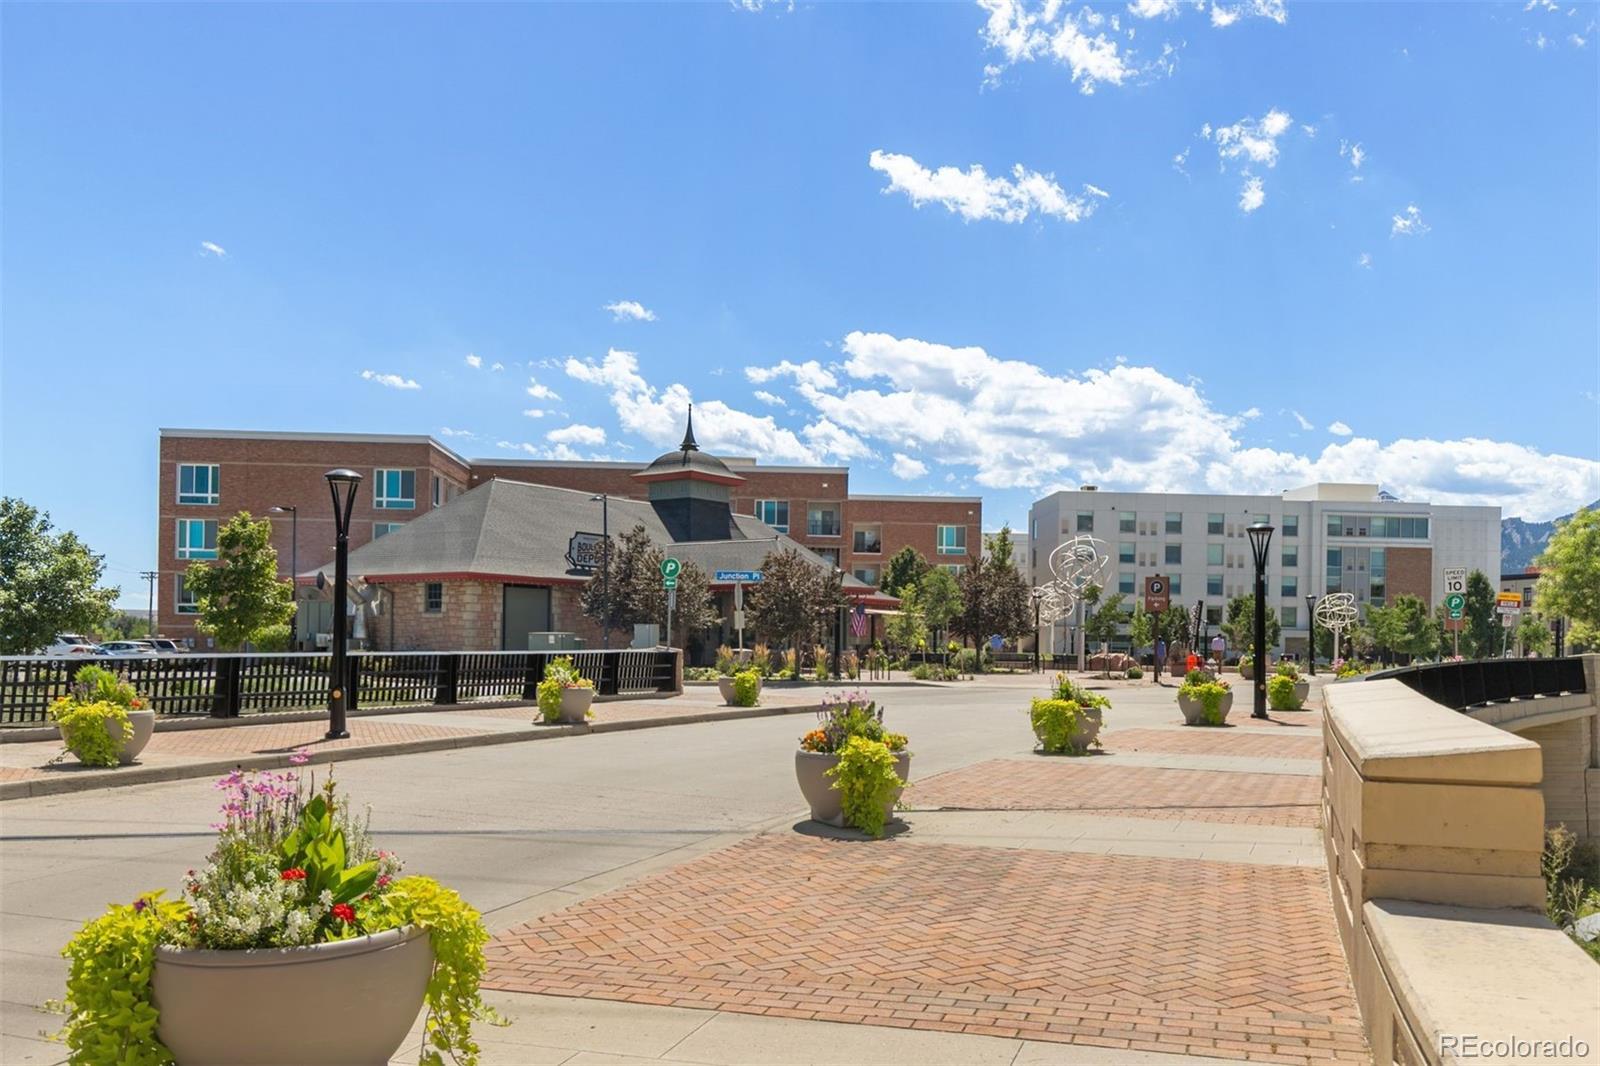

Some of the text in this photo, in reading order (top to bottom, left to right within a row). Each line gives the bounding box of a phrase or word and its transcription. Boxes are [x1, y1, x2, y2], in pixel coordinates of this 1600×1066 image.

[576, 554, 601, 564] DEPO
[665, 562, 676, 574] P
[719, 571, 749, 580] Junction
[1153, 583, 1161, 592] P
[1448, 581, 1462, 591] 10
[1451, 597, 1460, 608] P
